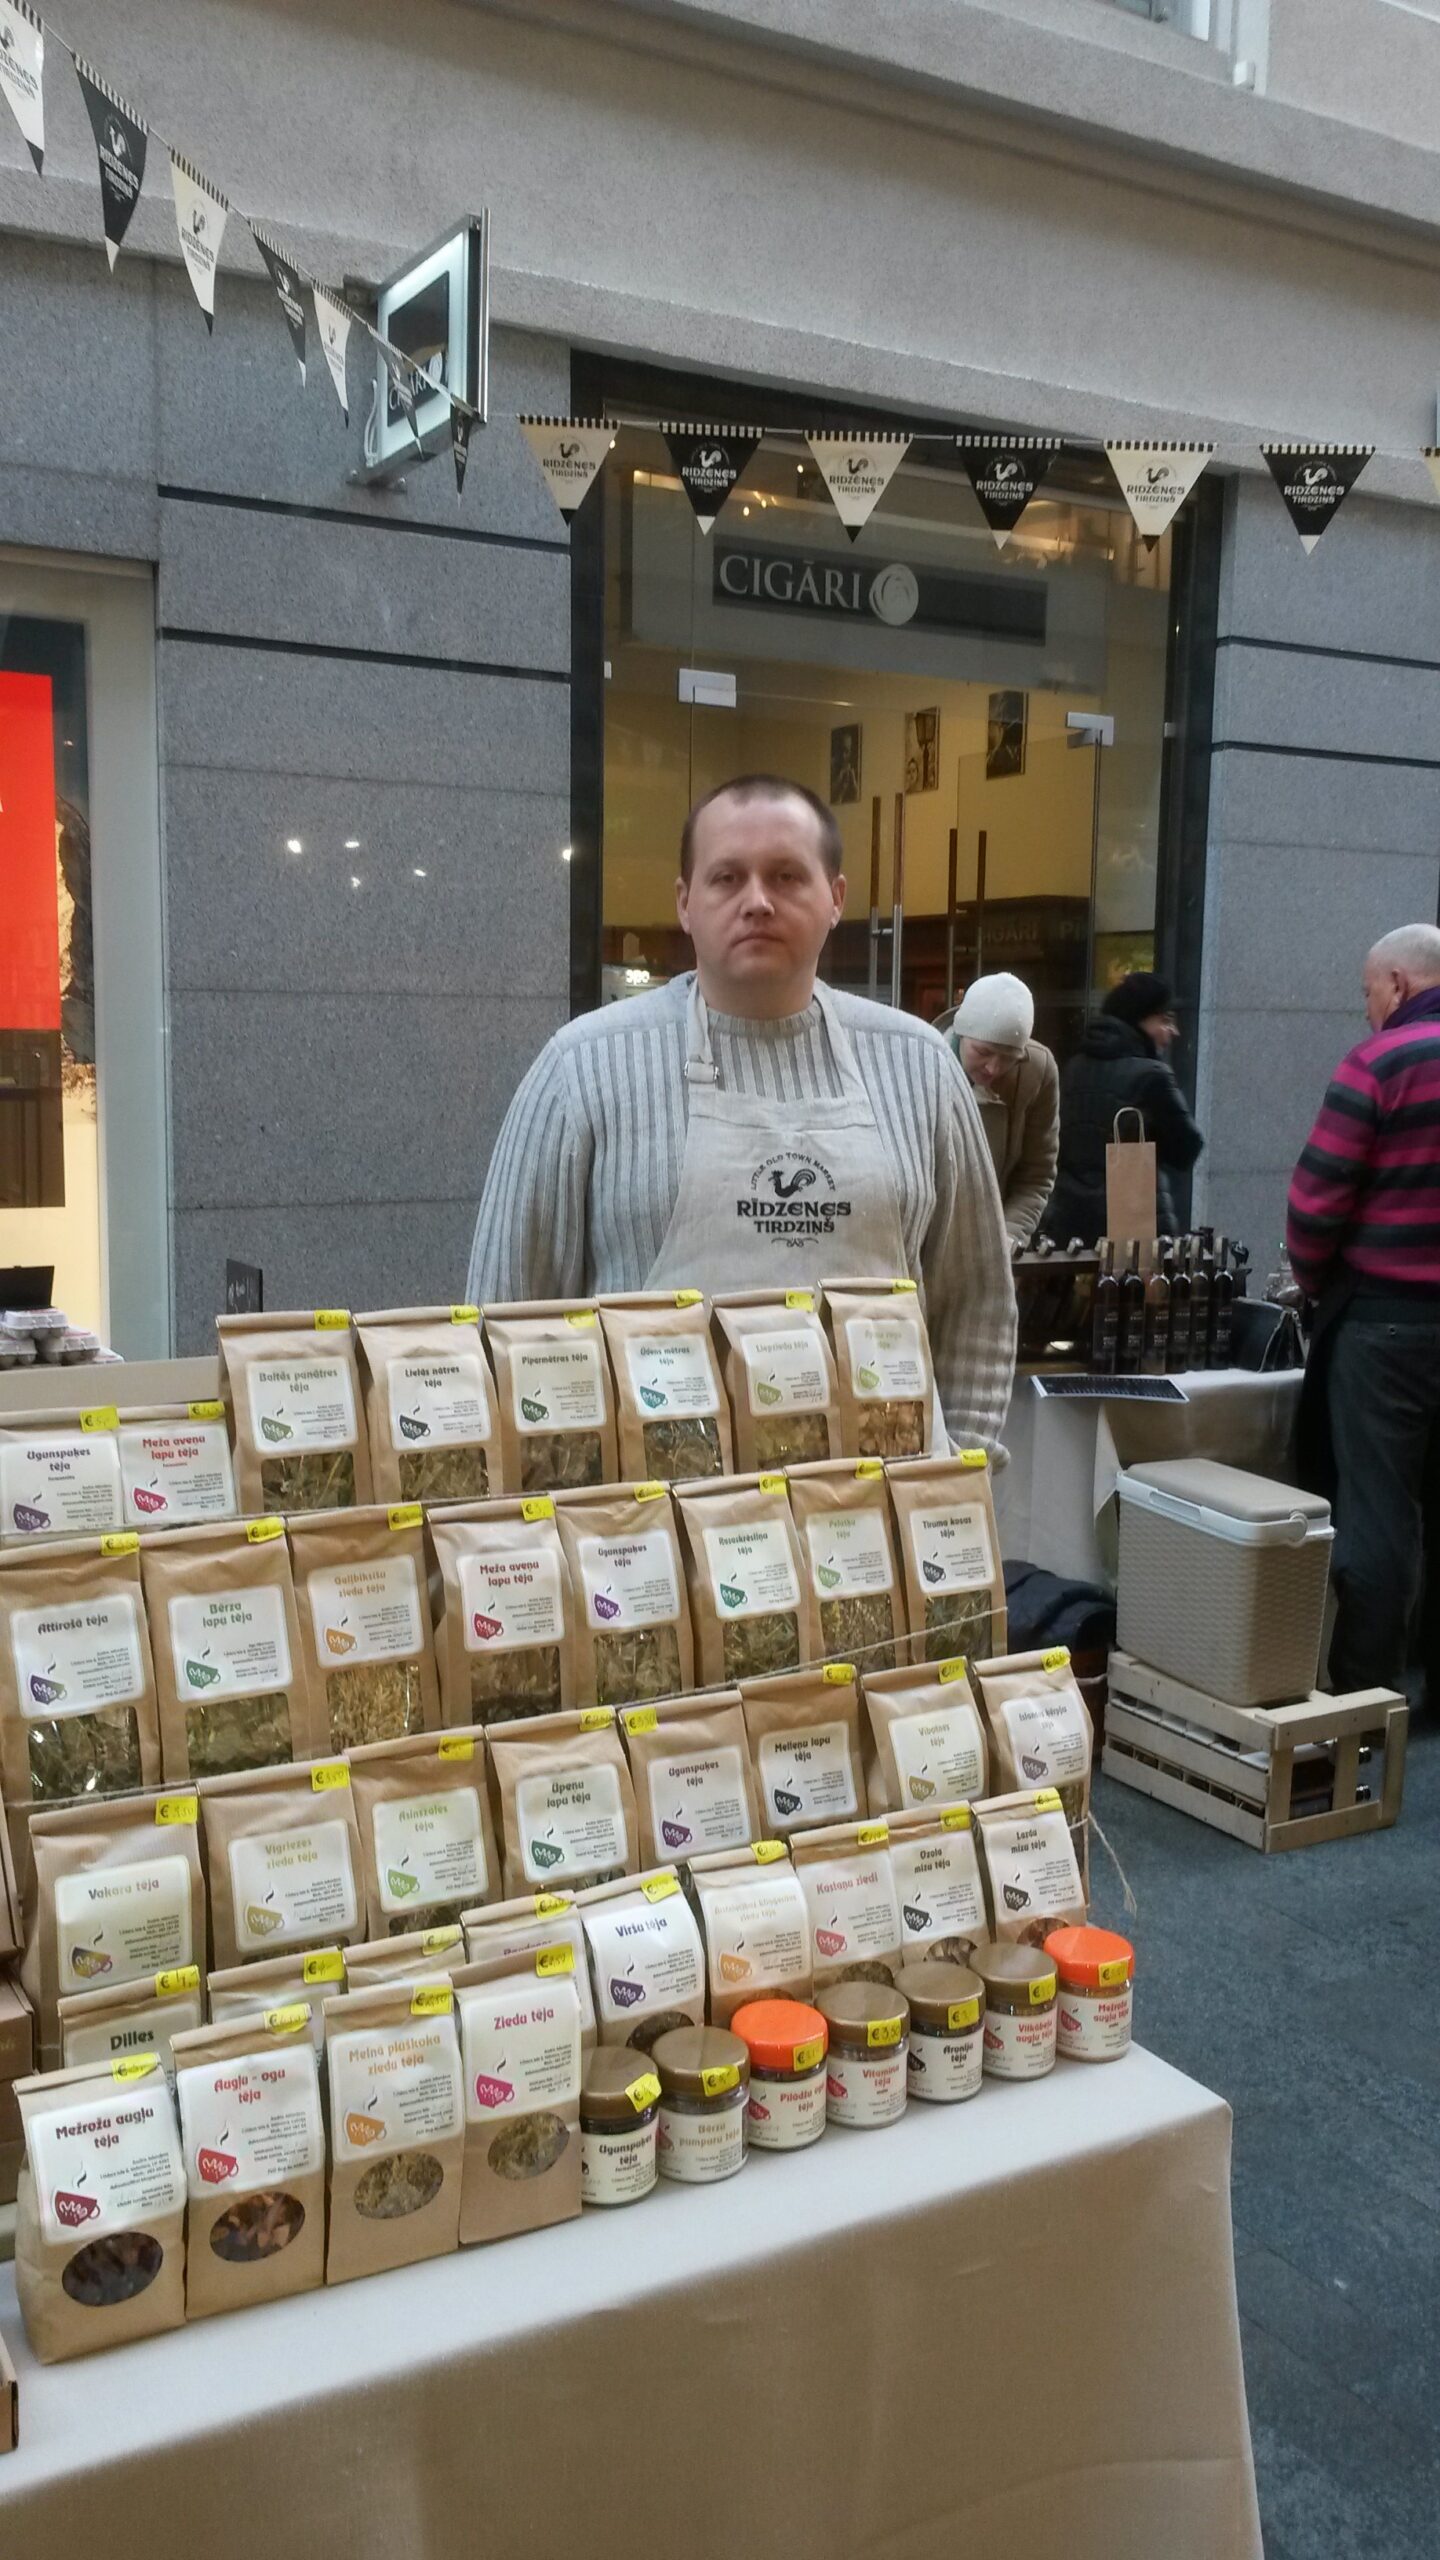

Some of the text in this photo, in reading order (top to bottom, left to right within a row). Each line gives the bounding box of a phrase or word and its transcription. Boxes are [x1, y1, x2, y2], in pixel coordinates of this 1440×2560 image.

[719, 554, 862, 611] CIGĀRI
[766, 1154, 784, 1166] OLD
[786, 1152, 812, 1164] TOWN
[142, 1436, 171, 1449] Meža
[151, 1446, 199, 1461] lapu tēja
[480, 1560, 540, 1575] Meža aveņu
[488, 1573, 534, 1588] lapu tēja
[202, 1612, 253, 1629] lapu tēja
[547, 1792, 591, 1809] lapu tēja
[493, 2007, 554, 2031] Ziedu tēja
[110, 2031, 154, 2051] Dilles
[367, 2055, 425, 2076] ziedu tēja
[261, 2069, 286, 2084] ogu
[56, 2107, 154, 2140] Mežrožu augļu
[94, 2134, 120, 2149] tēja
